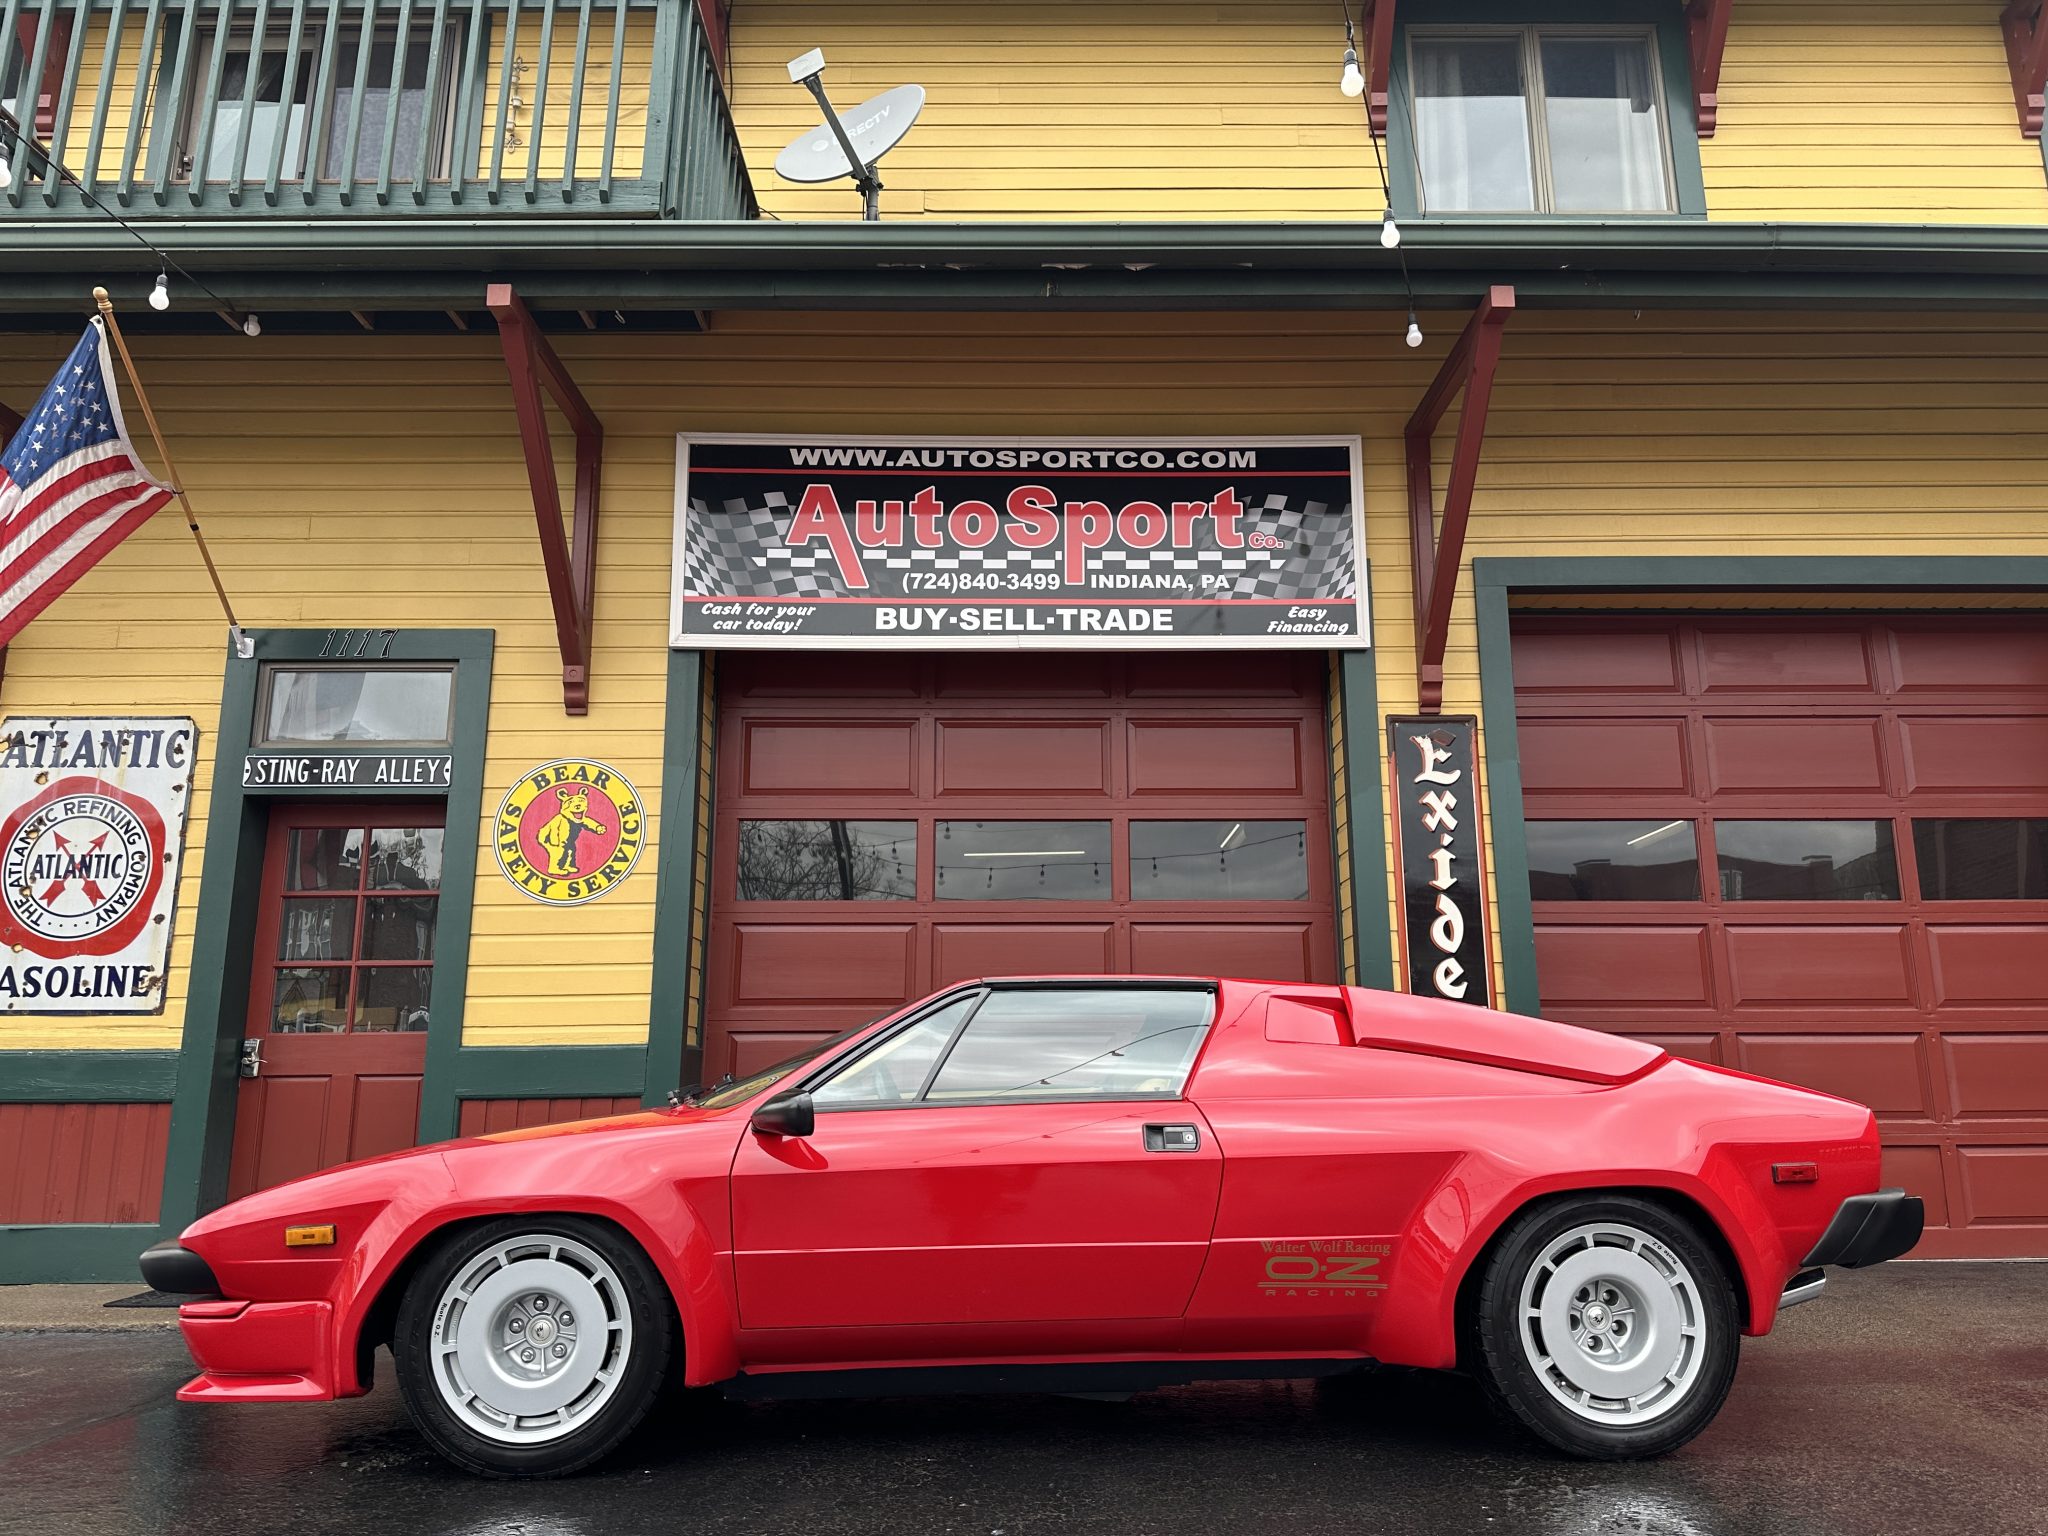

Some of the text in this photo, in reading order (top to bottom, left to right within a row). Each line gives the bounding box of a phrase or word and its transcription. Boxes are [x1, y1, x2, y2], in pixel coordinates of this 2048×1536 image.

[832, 105, 890, 146] DRECTV
[790, 448, 1256, 468] WWW.AUTOSPORTCO.COM
[785, 483, 1284, 588] AutoSport Co.
[902, 572, 1230, 593] (724)840-3499 INDIANA, PA
[701, 603, 816, 618] Cash for your
[1287, 606, 1327, 621] Easy
[713, 618, 803, 634] car today!
[1267, 620, 1349, 636] Financing
[318, 628, 399, 658] 1117
[0, 729, 190, 769] ATLANTIC
[254, 758, 441, 784] STING-RAY ALLEY
[530, 765, 612, 792] BEAR
[499, 800, 640, 898] SAFETY SERVICE
[8, 799, 146, 928] THE ATLANTIC REFINING COMPANY
[30, 853, 124, 880] ATLANTIC
[1408, 730, 1468, 999] Exide
[1260, 1240, 1392, 1256] Walter Wolf Racing
[1265, 1289, 1378, 1297] RACING
